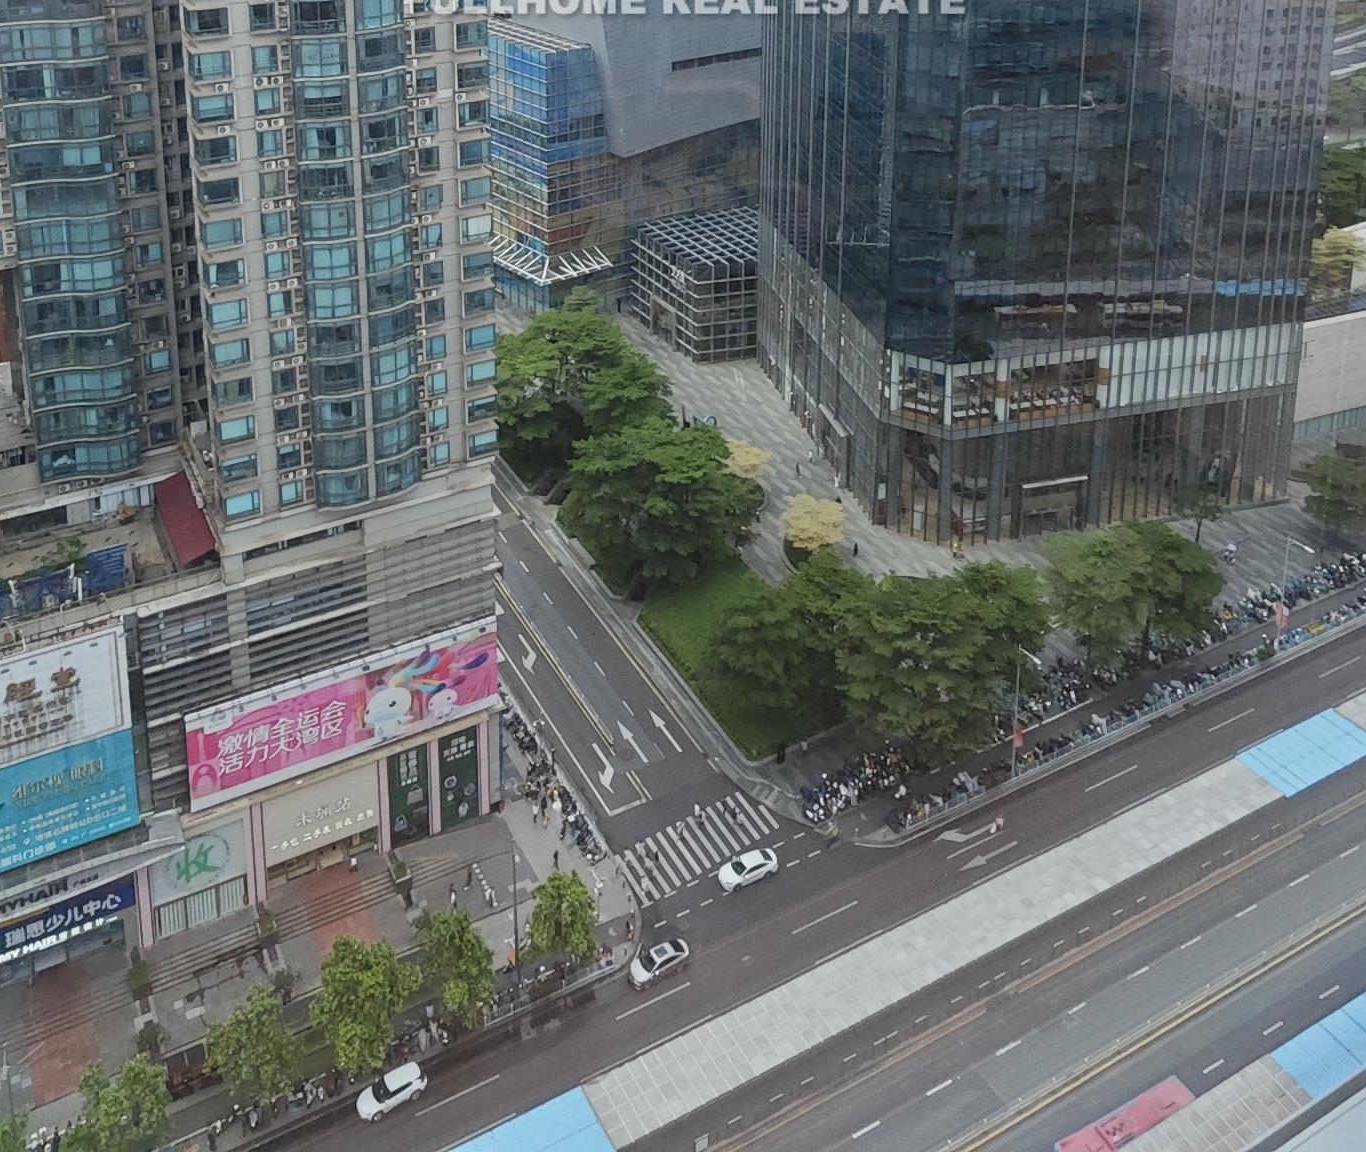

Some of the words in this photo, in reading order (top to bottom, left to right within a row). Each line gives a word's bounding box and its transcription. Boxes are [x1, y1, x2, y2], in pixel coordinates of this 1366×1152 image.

[217, 700, 347, 759] 激情全运会
[218, 717, 344, 777] 活力大湾区
[176, 843, 222, 884] 收
[4, 893, 122, 949] 瑞思少儿中心
